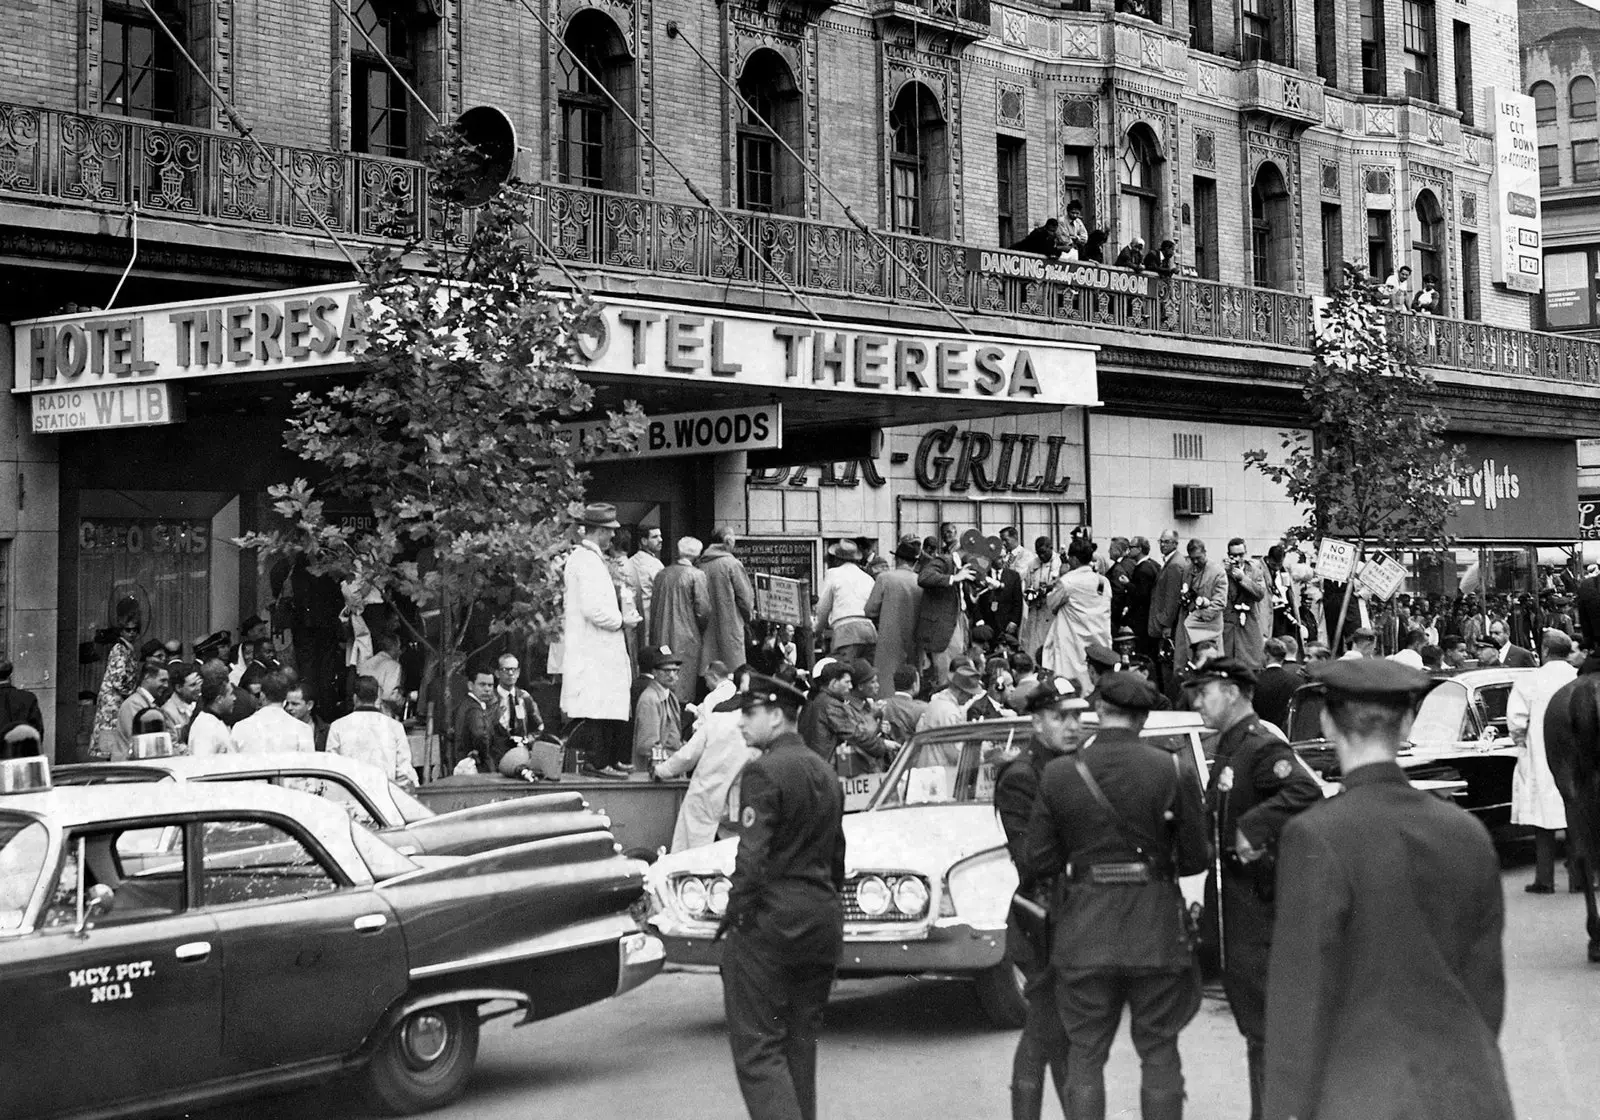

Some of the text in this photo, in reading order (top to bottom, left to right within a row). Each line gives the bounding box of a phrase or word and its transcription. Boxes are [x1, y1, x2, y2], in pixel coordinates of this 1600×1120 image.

[1510, 121, 1524, 135] CUT
[1513, 137, 1534, 153] DOWN
[981, 251, 1045, 279] DANCING
[1076, 267, 1110, 289] GOLD
[1110, 272, 1148, 295] ROOM
[31, 294, 371, 381] HOTEL THERESA
[578, 309, 1042, 397] OTEL THERESA
[35, 411, 86, 429] STATION
[39, 387, 163, 425] RADIO WLIB
[1330, 544, 1346, 555] NO
